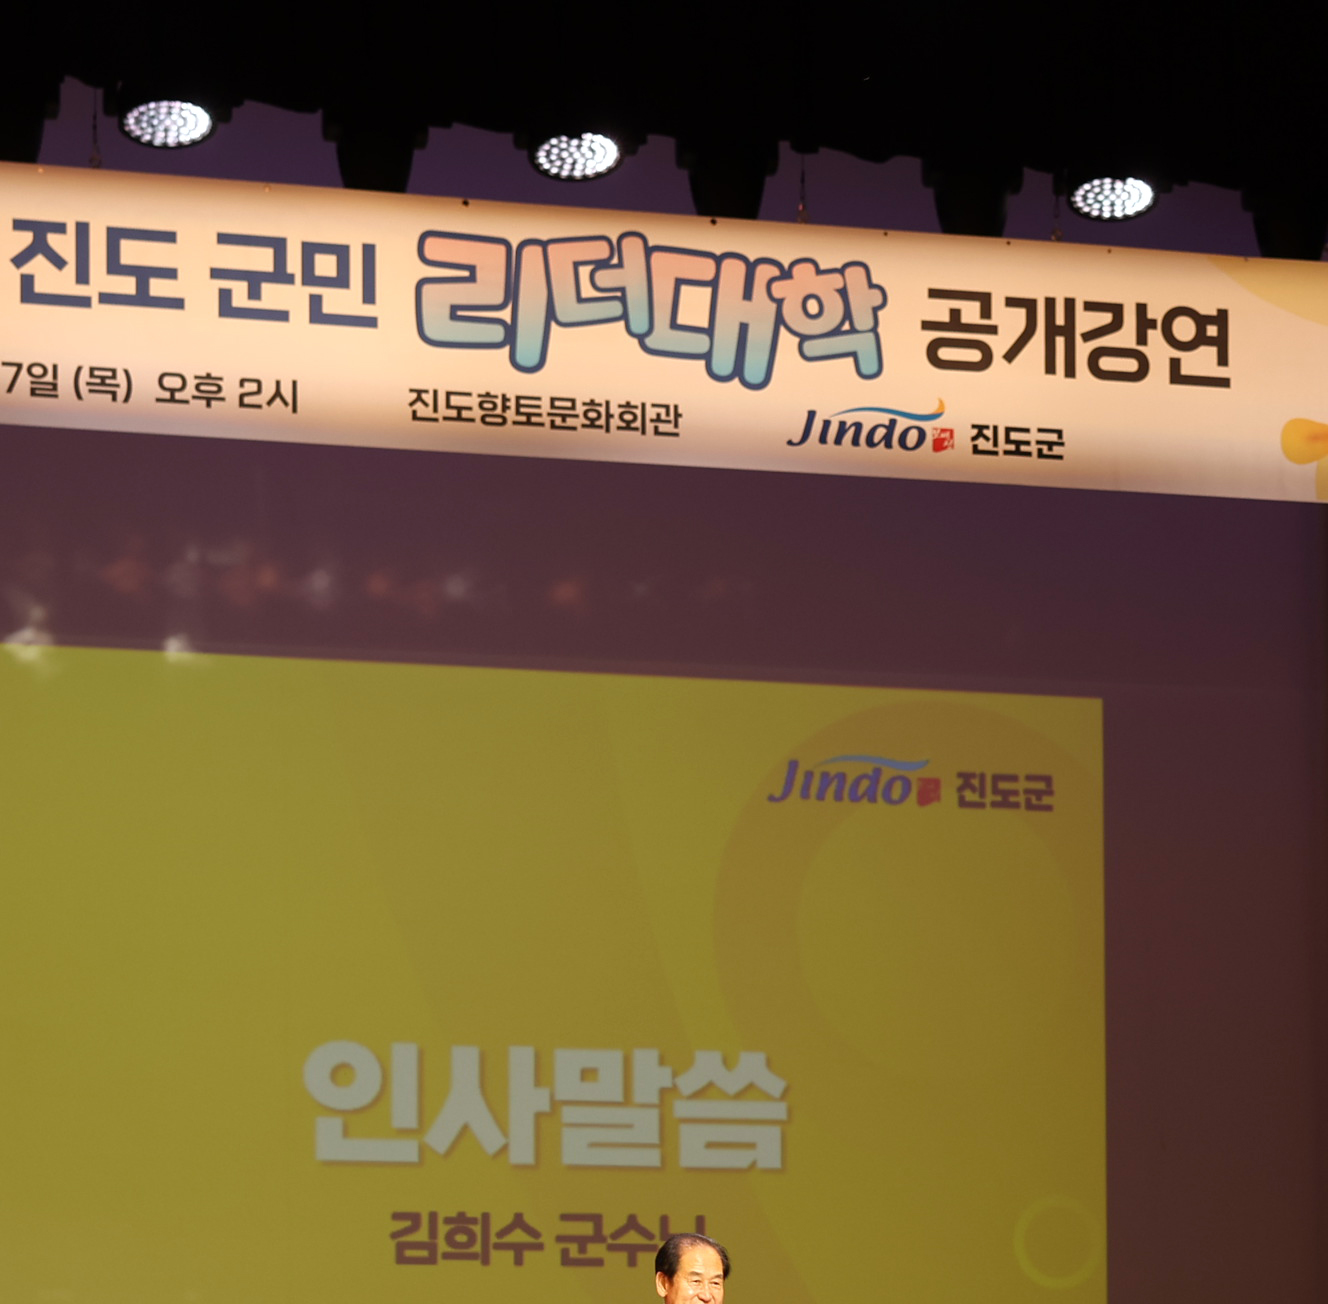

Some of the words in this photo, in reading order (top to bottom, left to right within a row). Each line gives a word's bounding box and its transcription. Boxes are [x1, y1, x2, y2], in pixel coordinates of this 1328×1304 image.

[9, 217, 186, 310] 진도
[208, 231, 379, 329] 군민
[414, 229, 888, 392] 리더대학
[919, 286, 1233, 390] 공개강연
[73, 365, 134, 404] (목)
[155, 370, 226, 410] 오후
[237, 377, 299, 414] 2시
[407, 387, 684, 438] 진도향토문화회관
[786, 409, 927, 452] Jindo
[970, 423, 1066, 460] 진도군
[767, 758, 912, 806] Jindo
[956, 771, 1055, 812] 진도군
[302, 1039, 789, 1170] 인사말씀
[389, 1210, 546, 1267] 김희수
